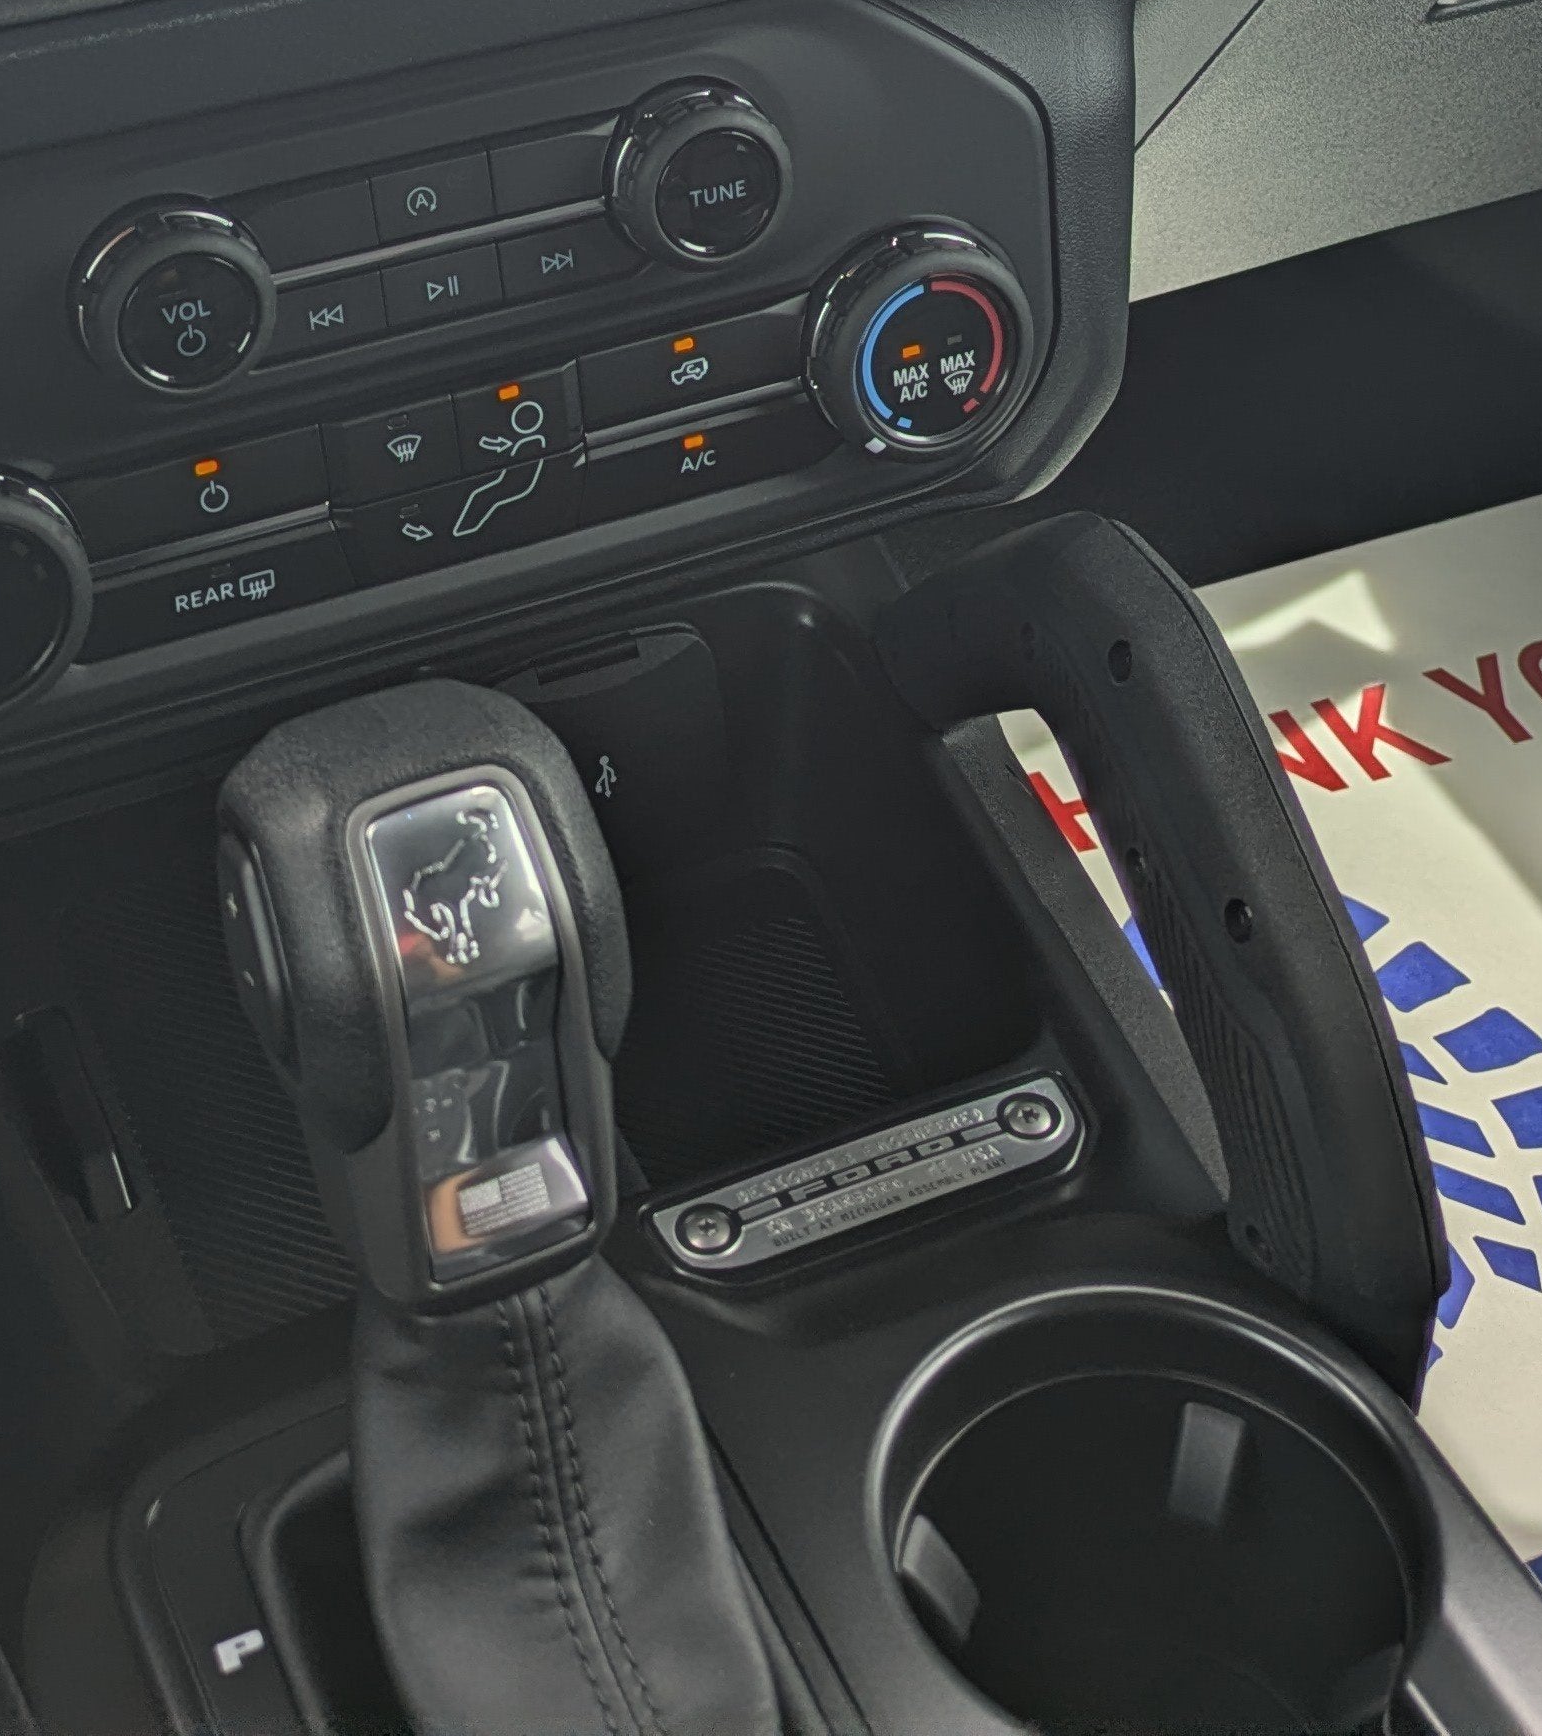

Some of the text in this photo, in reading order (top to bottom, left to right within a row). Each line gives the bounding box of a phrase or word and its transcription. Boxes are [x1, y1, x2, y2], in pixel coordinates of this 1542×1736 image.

[414, 191, 430, 208] A
[688, 179, 748, 208] TUNE
[161, 299, 211, 325] VOL
[893, 361, 930, 389] MAX
[939, 349, 976, 375] MAX
[899, 380, 929, 404] A/C
[680, 449, 717, 475] A/C
[174, 581, 235, 614] REAR
[787, 1133, 956, 1203] FORD
[213, 1628, 265, 1675] P
